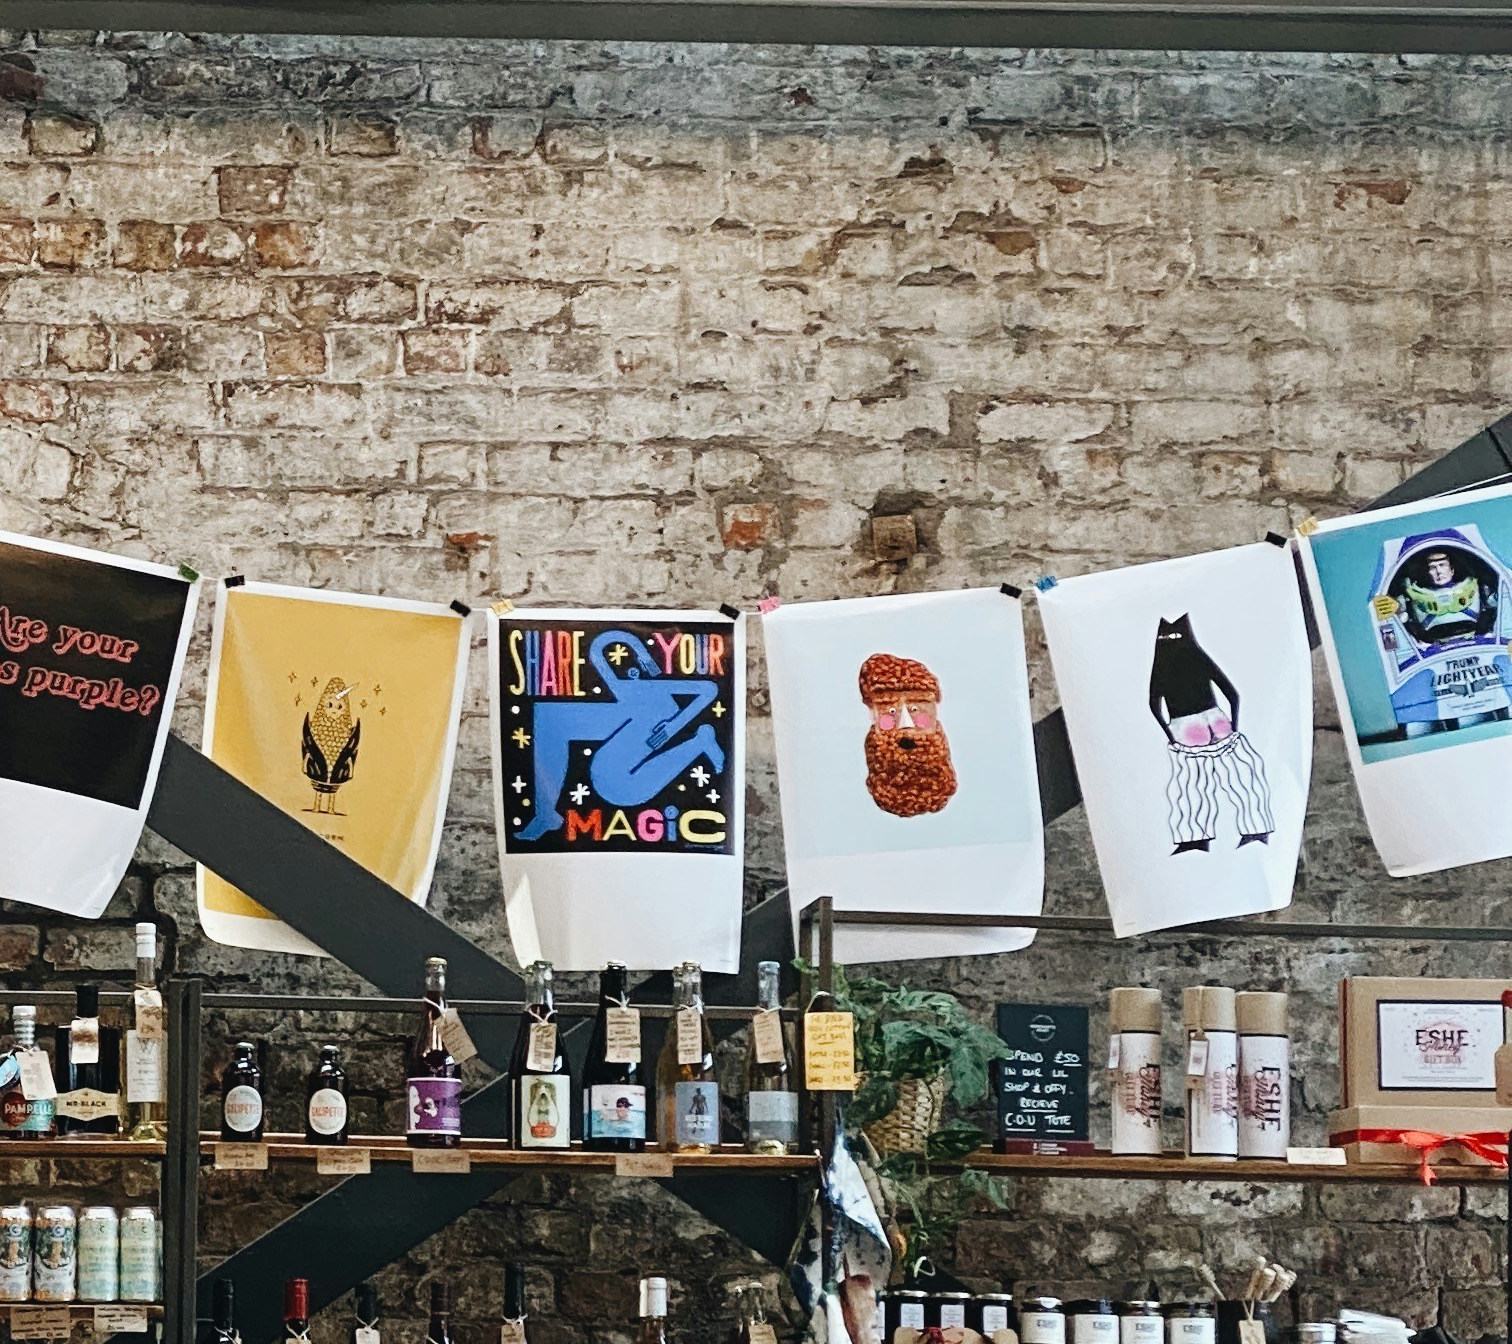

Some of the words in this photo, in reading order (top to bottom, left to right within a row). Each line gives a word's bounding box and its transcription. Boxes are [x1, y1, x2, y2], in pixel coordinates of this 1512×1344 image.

[52, 625, 139, 663] your
[509, 629, 586, 697] SHARE
[653, 632, 726, 676] YOUR
[1429, 663, 1505, 688] LIGHTYEAR
[1446, 656, 1480, 671] TRUMP
[22, 668, 160, 717] purple?
[1415, 1029, 1470, 1046] ESHE
[1261, 1066, 1281, 1131] ESHE
